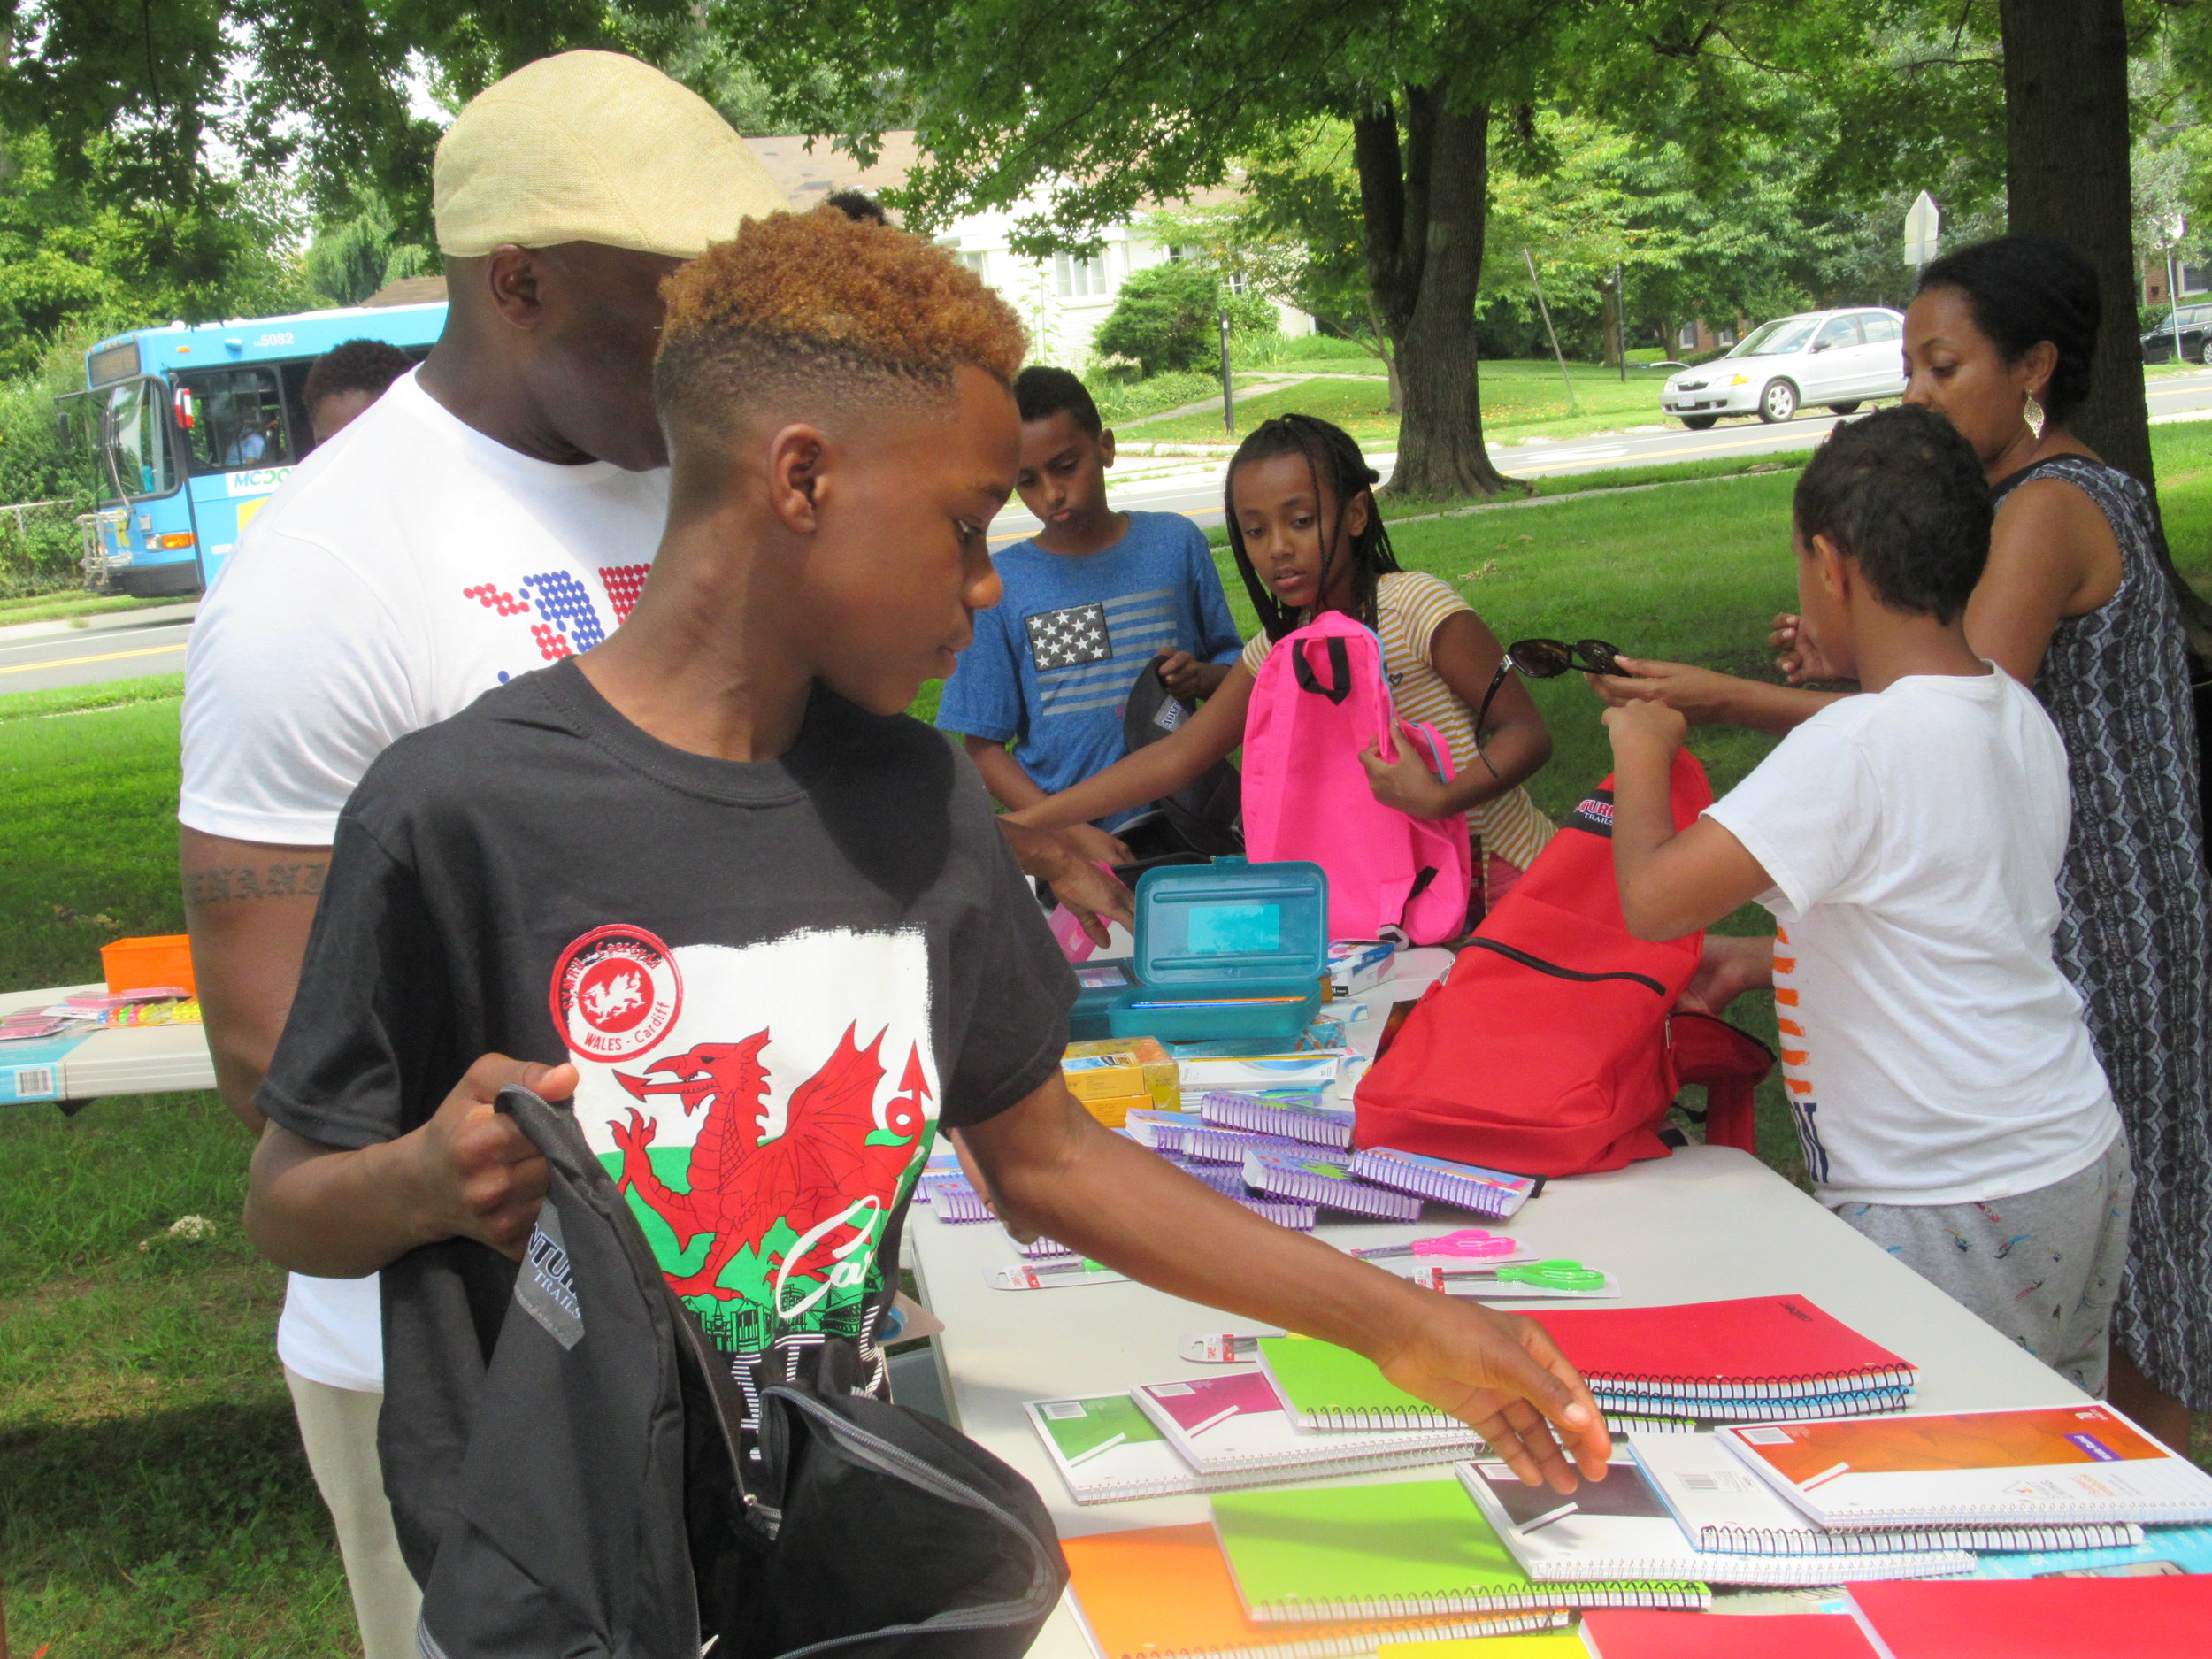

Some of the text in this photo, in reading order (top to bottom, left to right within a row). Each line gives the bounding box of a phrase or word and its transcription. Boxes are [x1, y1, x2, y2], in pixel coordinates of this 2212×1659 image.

[1584, 812, 1614, 826] TRAILS
[584, 1032, 622, 1051] WALES
[634, 1001, 671, 1043] Cardiff
[534, 1269, 581, 1320] TRAILS
